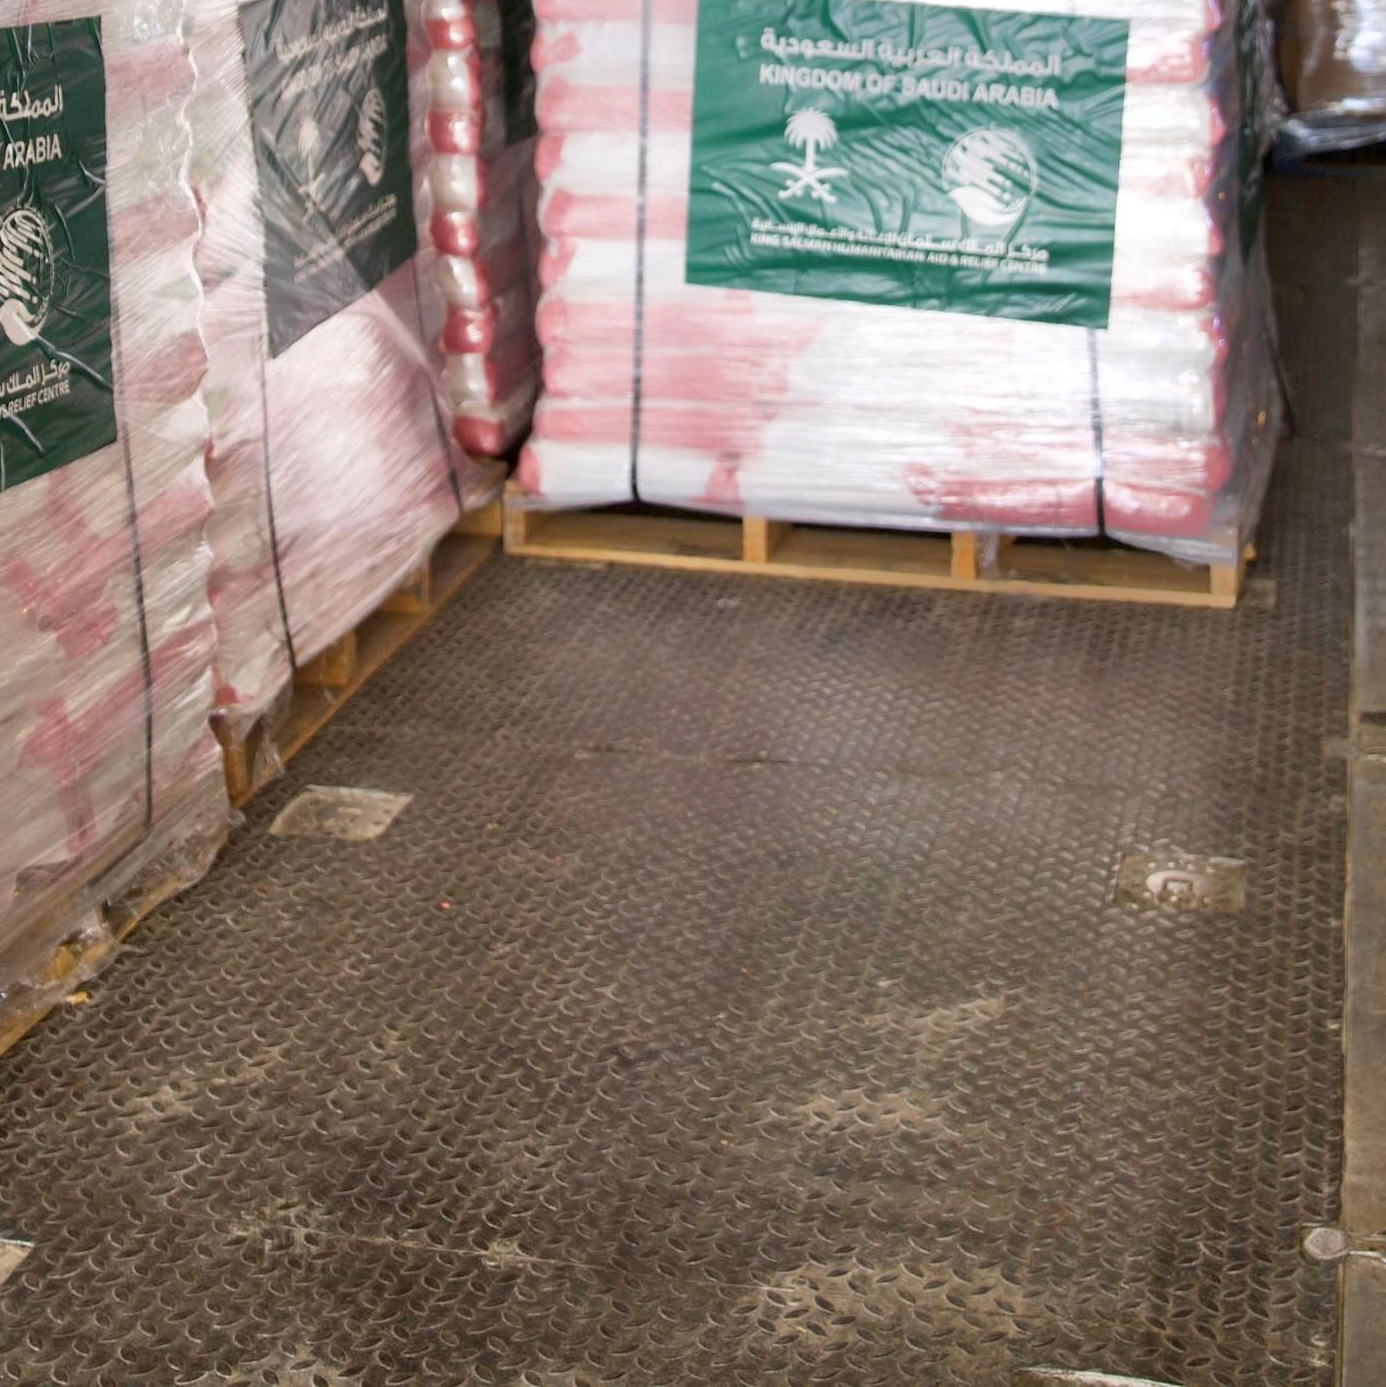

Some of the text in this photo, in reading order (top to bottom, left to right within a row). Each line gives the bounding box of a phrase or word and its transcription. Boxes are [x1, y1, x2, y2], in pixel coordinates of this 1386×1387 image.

[760, 27, 876, 61] السعودية
[965, 44, 1062, 77] المملكة
[759, 63, 1060, 110] KINGDOM OF SAUDI ARABIA
[3, 132, 63, 173] ARABIA
[8, 392, 37, 414] RELIEF
[37, 379, 70, 405] CENTRE
